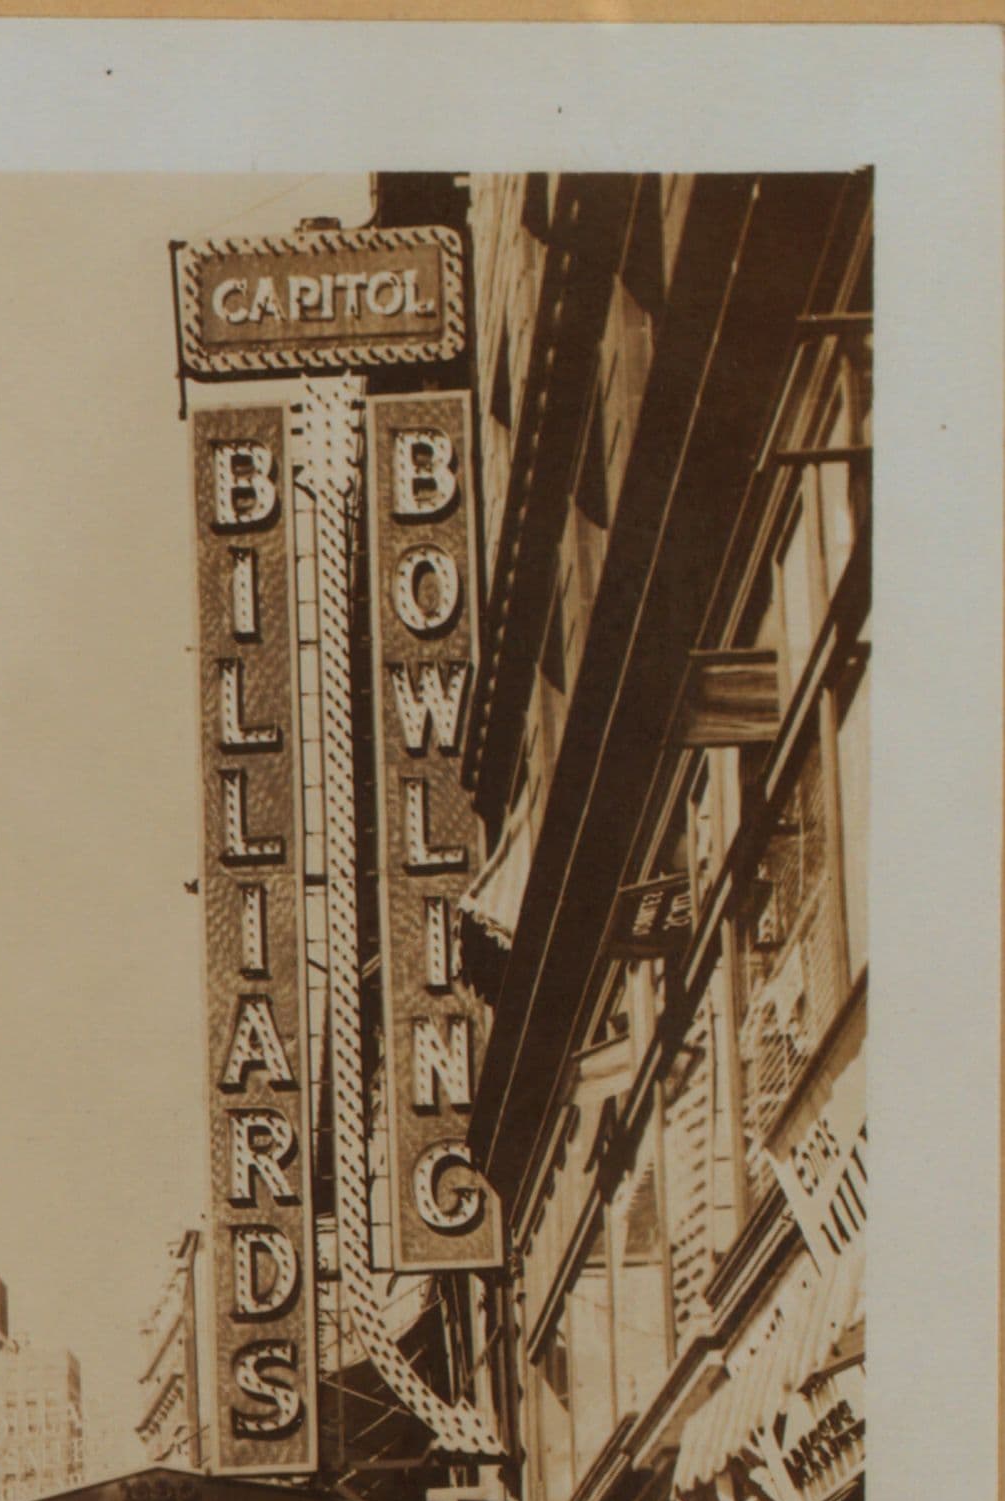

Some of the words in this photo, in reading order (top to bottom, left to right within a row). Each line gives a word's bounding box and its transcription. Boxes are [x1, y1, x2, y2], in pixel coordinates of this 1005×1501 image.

[210, 268, 435, 324] CAPITOL
[210, 438, 305, 1441] BILLIARDS
[391, 428, 486, 1232] BOWLING
